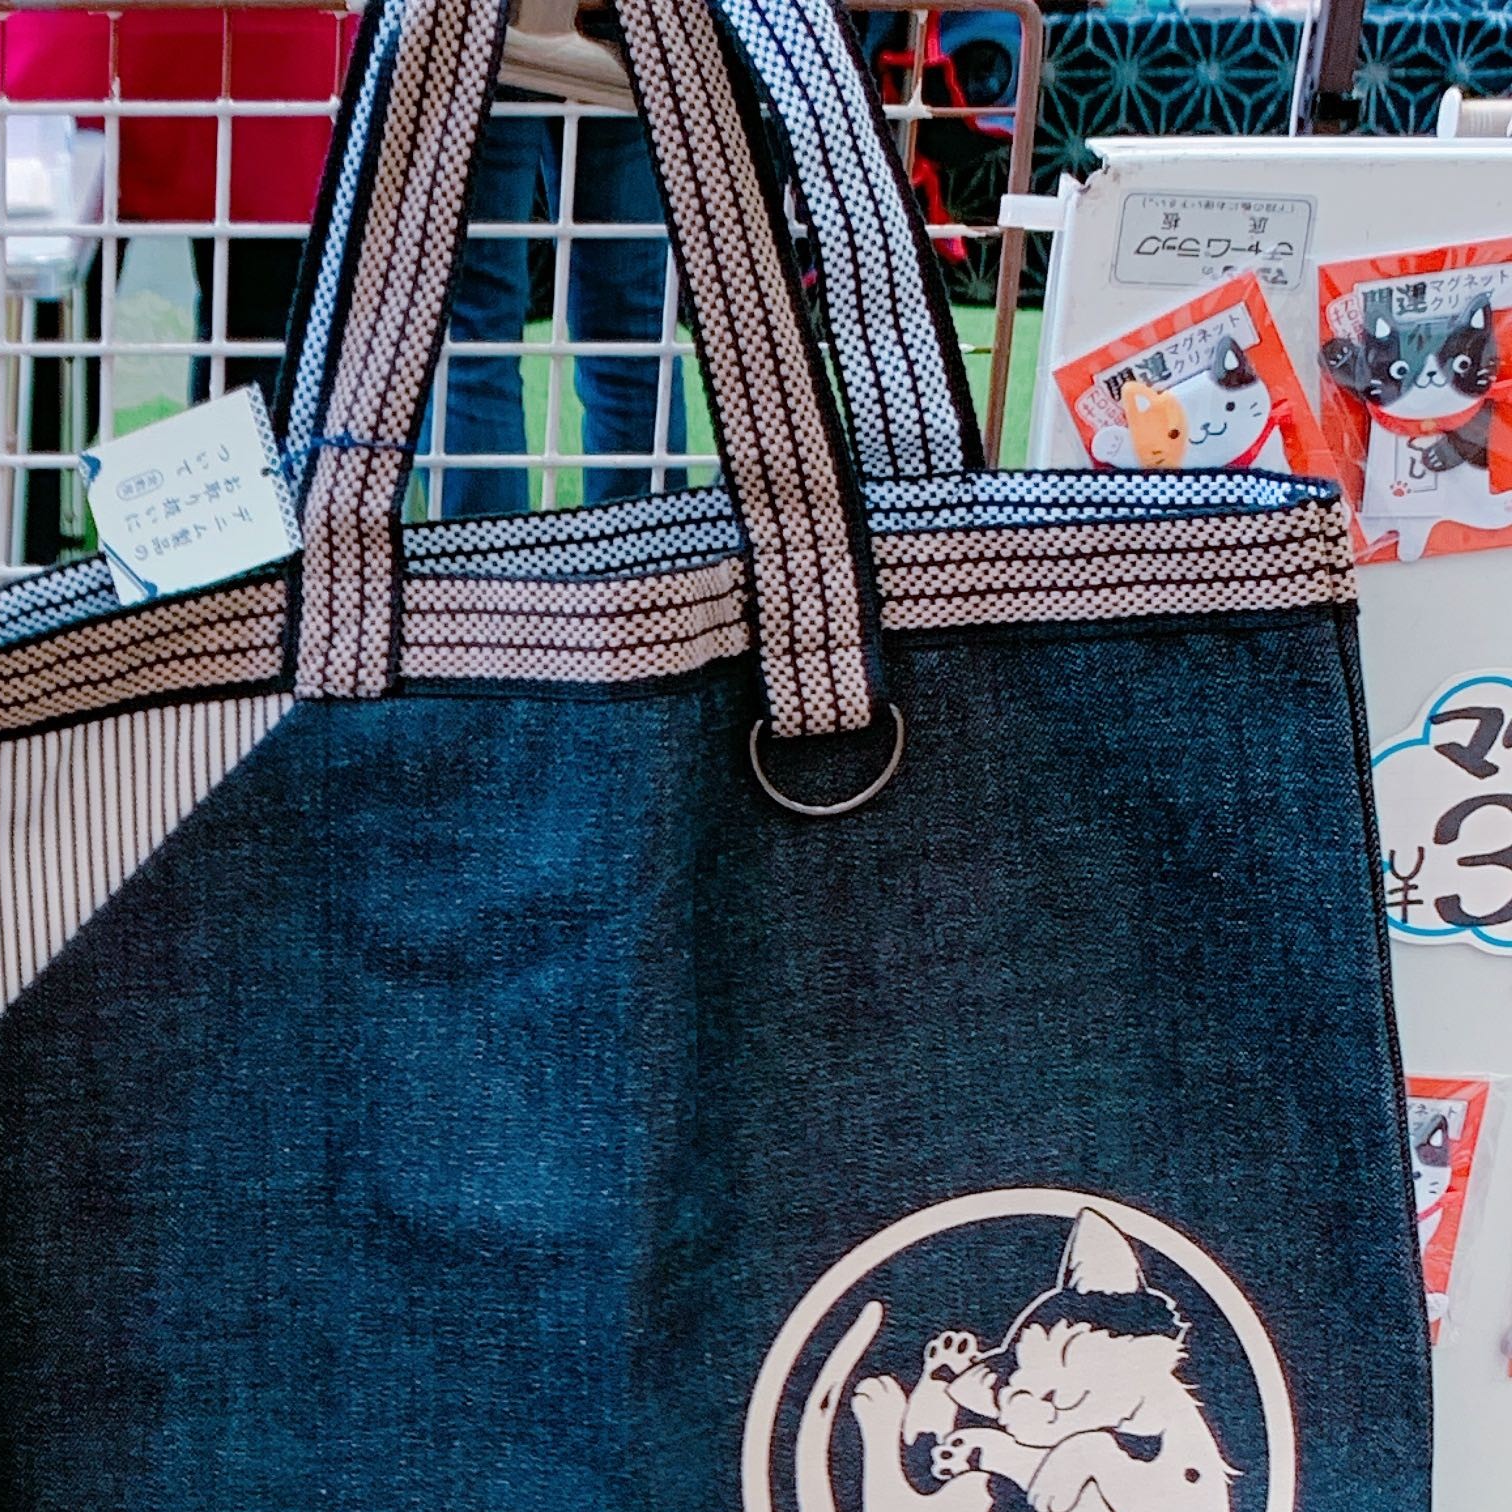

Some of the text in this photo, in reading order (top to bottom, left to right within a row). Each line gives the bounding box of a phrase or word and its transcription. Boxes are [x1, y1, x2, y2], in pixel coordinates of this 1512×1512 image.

[1429, 270, 1511, 294] マグネット
[1165, 312, 1241, 360] マグネット
[1431, 707, 1512, 779] マ
